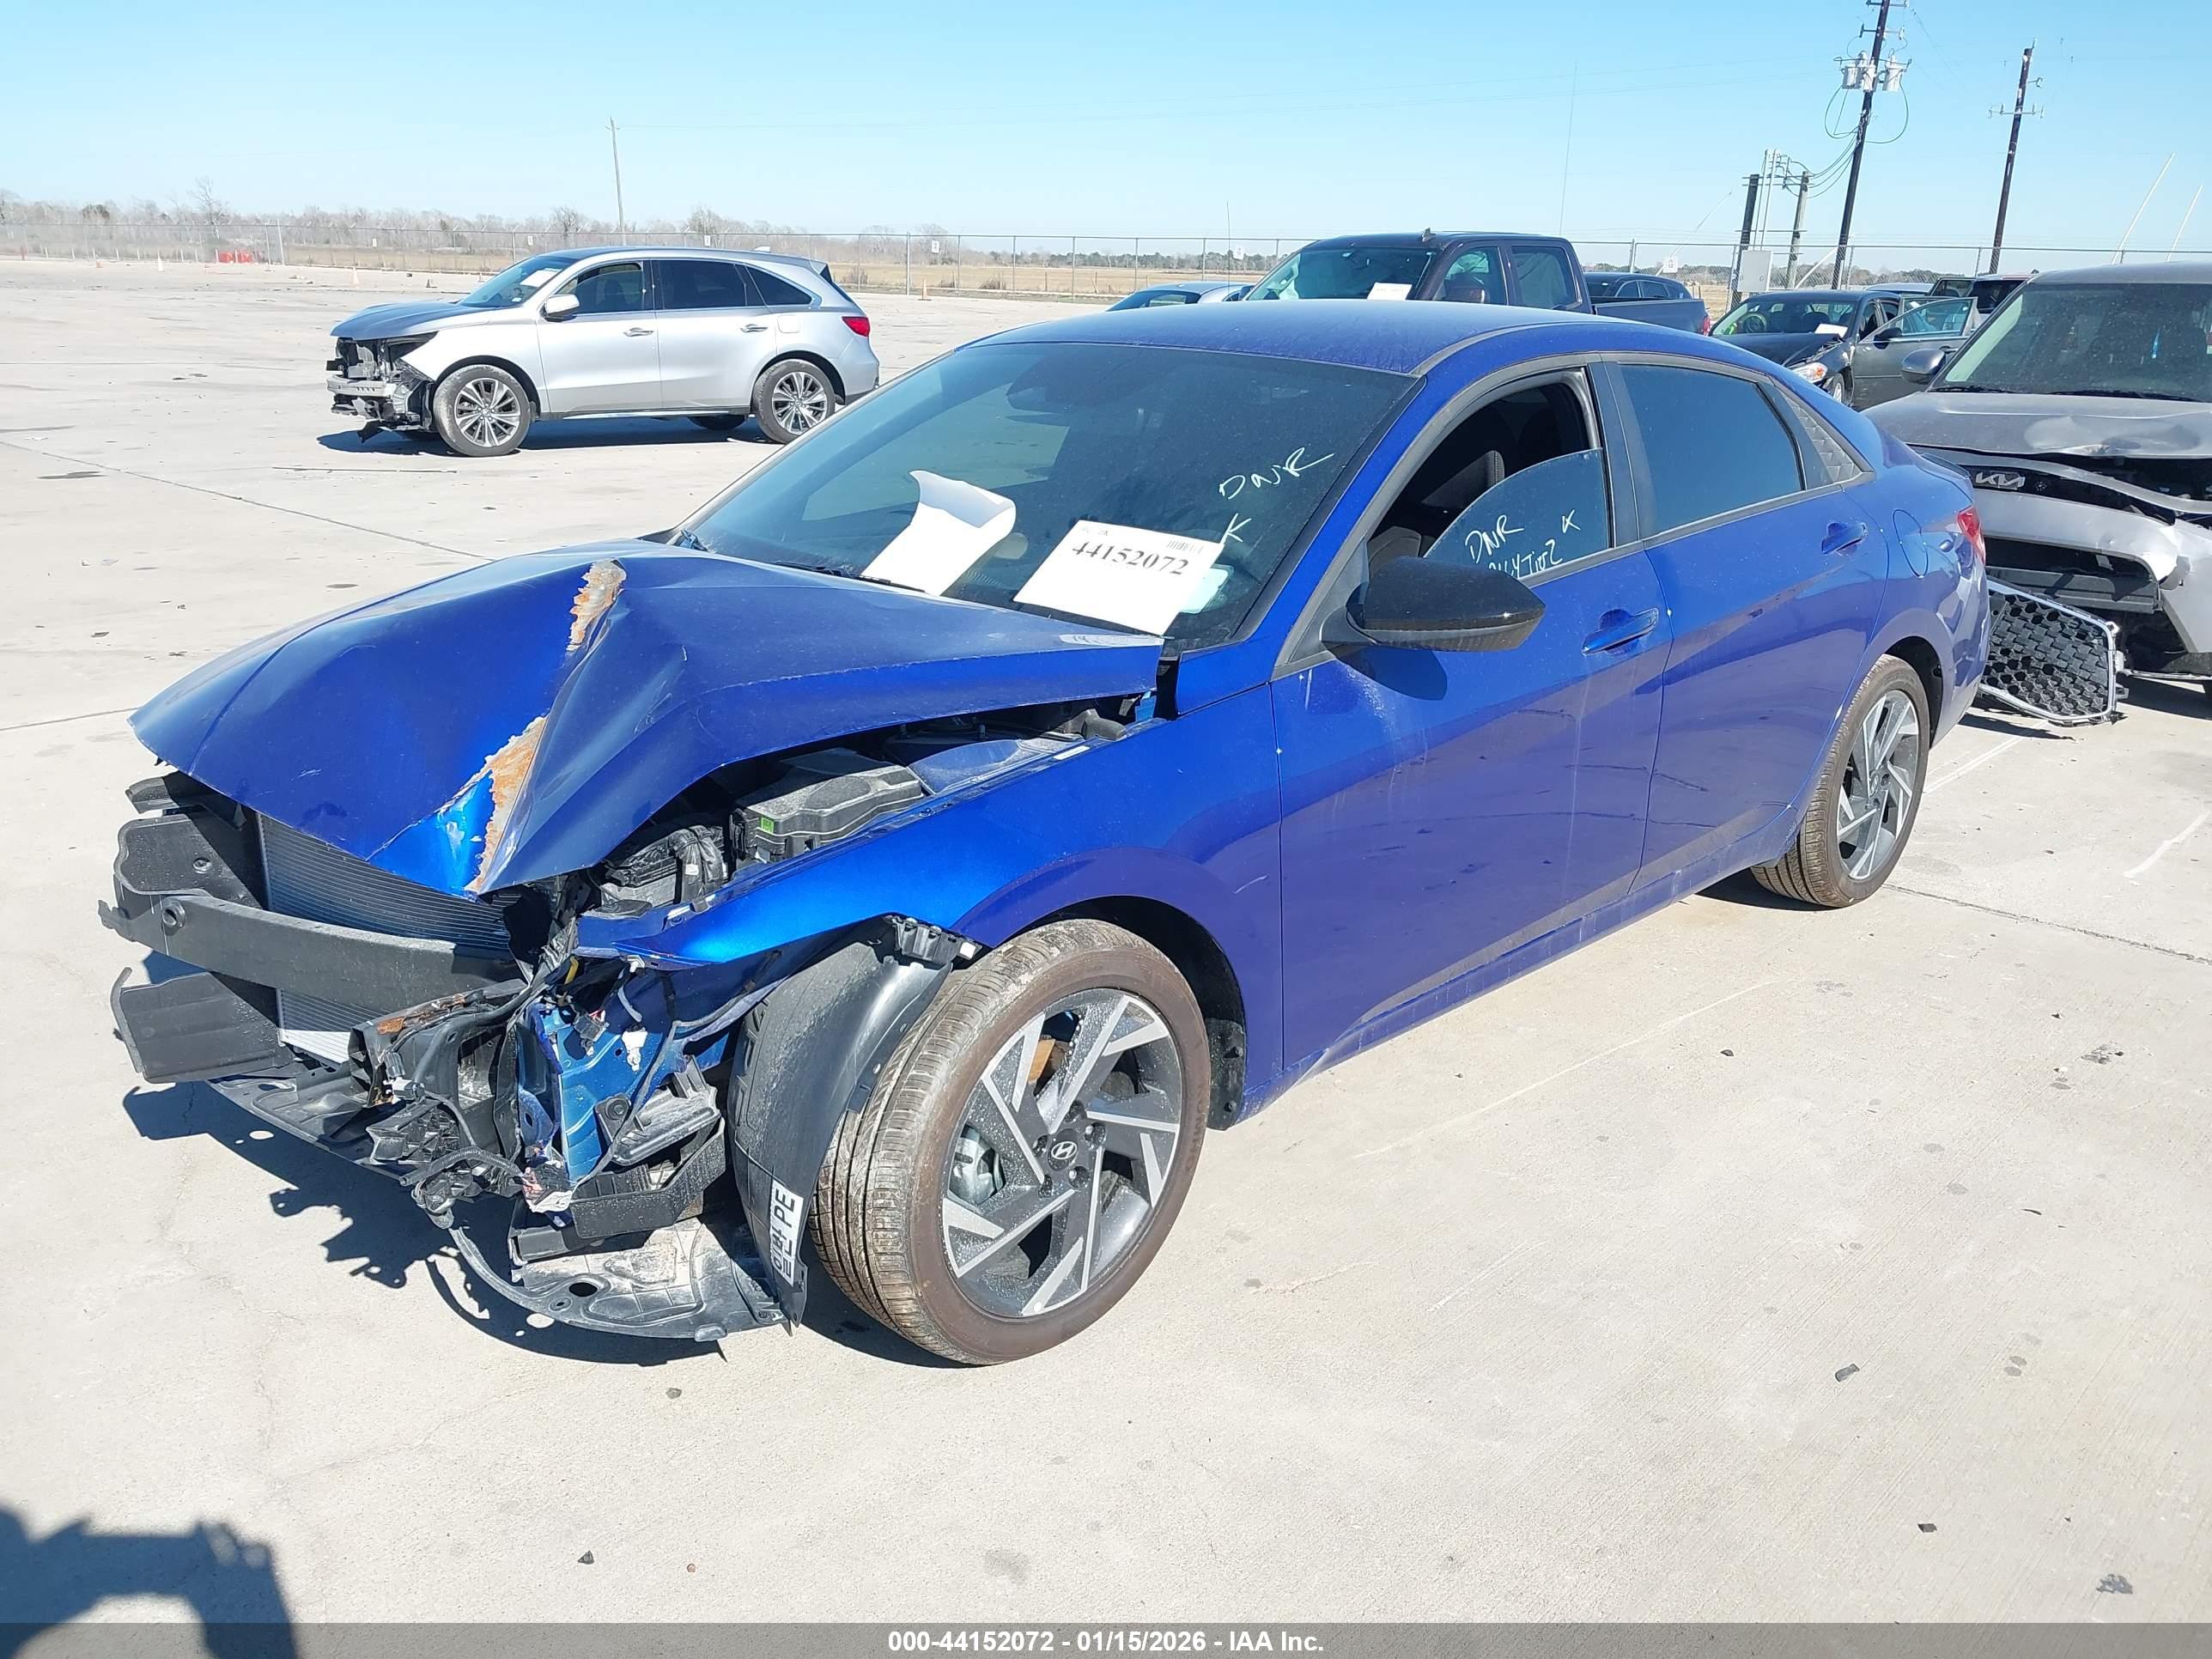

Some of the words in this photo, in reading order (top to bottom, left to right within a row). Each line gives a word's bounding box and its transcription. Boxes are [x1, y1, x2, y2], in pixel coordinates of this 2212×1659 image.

[1220, 513, 1252, 544] K
[1465, 514, 1525, 564] DNR
[1071, 539, 1190, 576] 44152072
[774, 1188, 795, 1228] PE
